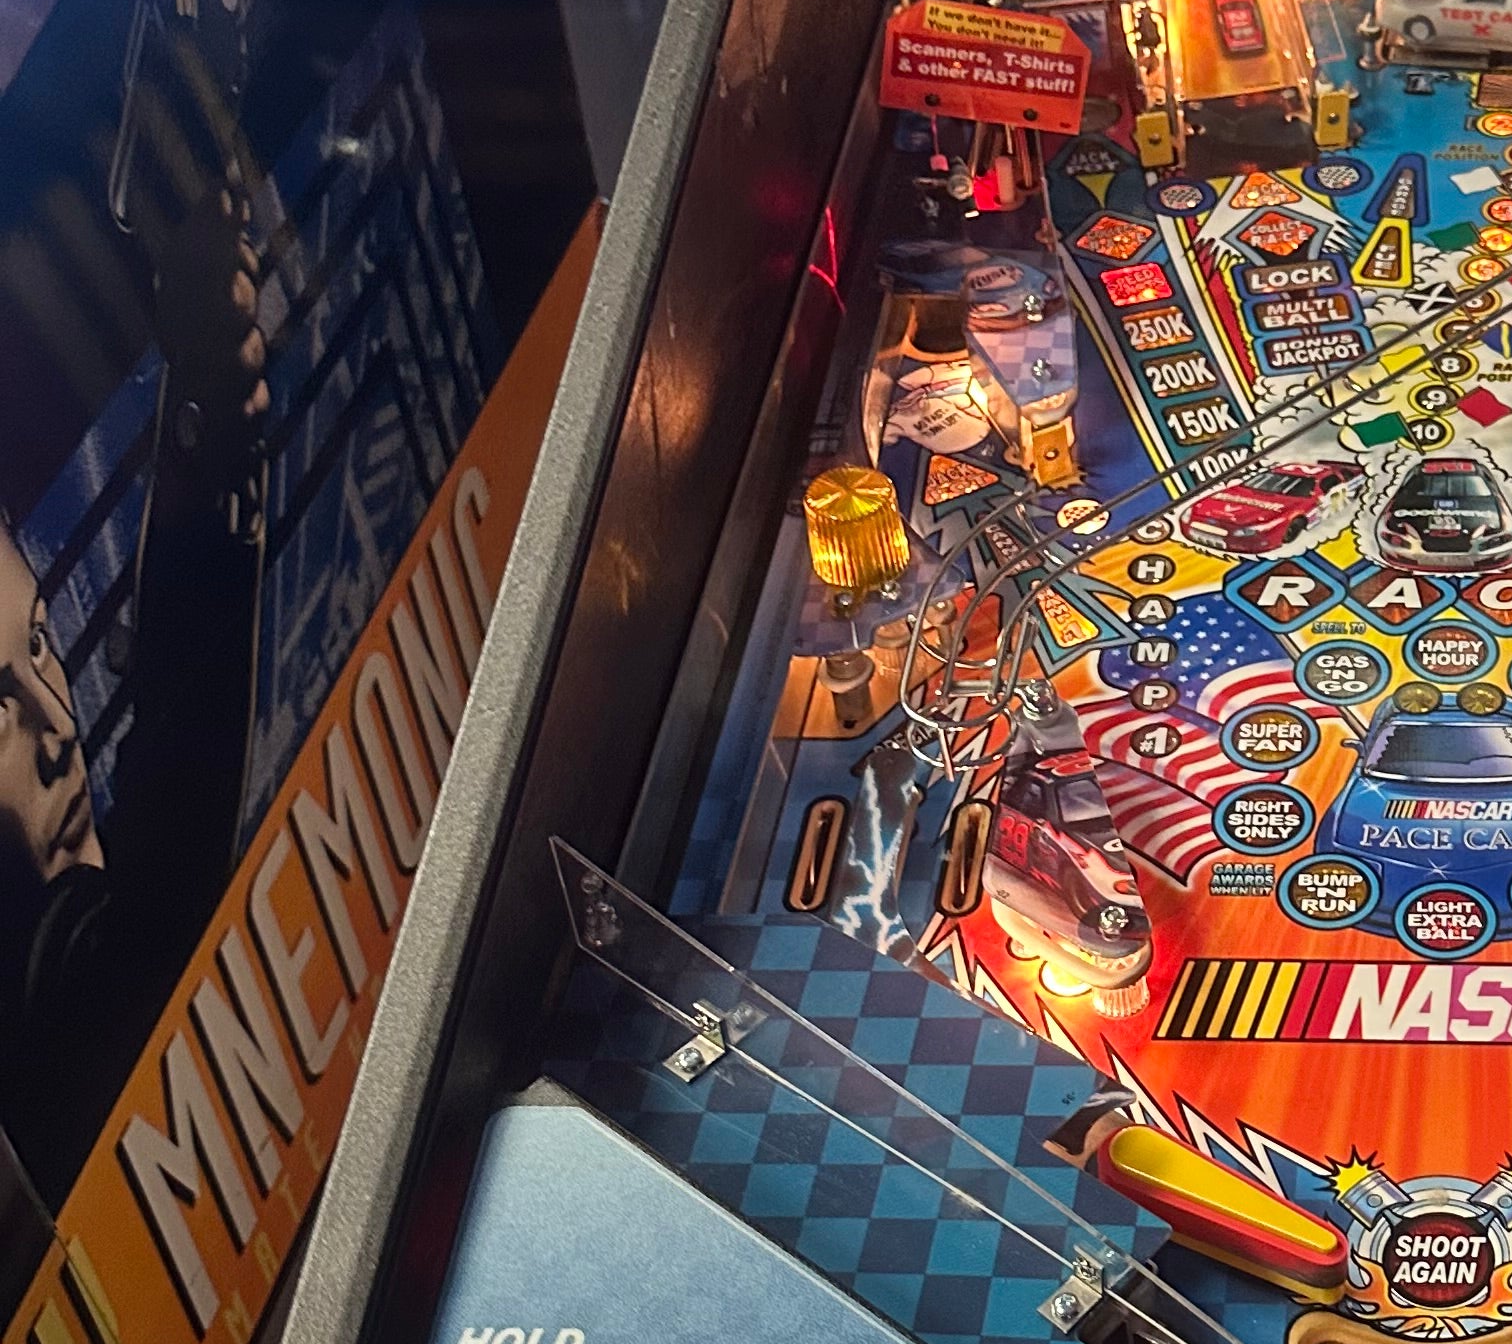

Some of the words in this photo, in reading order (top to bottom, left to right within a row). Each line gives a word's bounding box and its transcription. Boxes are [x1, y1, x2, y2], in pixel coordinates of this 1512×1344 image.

[944, 11, 964, 21] we
[968, 14, 1001, 28] don't
[1005, 20, 1037, 34] have
[1440, 8, 1486, 22] TEST
[928, 18, 953, 33] You
[956, 25, 990, 39] don't
[899, 38, 993, 67] Scanners,
[1003, 52, 1076, 76] T-Shirts
[898, 57, 913, 73] &
[918, 60, 968, 80] other
[973, 67, 1021, 87] FAST
[1025, 76, 1076, 94] stuff!
[1250, 220, 1303, 236] COLLECT
[1250, 265, 1335, 290] LOCK
[1267, 298, 1336, 315] MULTI
[1263, 312, 1351, 329] BALL
[1123, 312, 1195, 348] 250K
[1271, 334, 1354, 353] BONUS
[1270, 343, 1362, 368] JACKPOT
[1440, 358, 1460, 374] 8
[1146, 357, 1217, 393] 200K
[1427, 390, 1447, 407] 9
[1168, 402, 1241, 441] 150K
[1412, 423, 1440, 441] 10
[1137, 521, 1162, 541] C
[1136, 561, 1165, 580] H
[1256, 575, 1316, 606] R
[1366, 577, 1423, 609] A
[1138, 600, 1167, 619] A
[1137, 642, 1170, 663] M
[1417, 639, 1484, 653] HAPPY
[1316, 655, 1371, 669] GAS
[1422, 652, 1479, 667] HOUR
[1142, 685, 1169, 706] P
[1316, 680, 1369, 694] GO
[1238, 722, 1304, 739] SUPER
[1139, 727, 1169, 756] #1
[1237, 738, 1303, 753] FAN
[1234, 799, 1294, 813] RIGHT
[1227, 813, 1301, 827] SIDES
[1233, 826, 1294, 840] ONLY
[1359, 823, 1454, 850] PACE
[1212, 863, 1275, 875] GARAGE
[1210, 874, 1275, 886] AWARDS
[1297, 874, 1363, 887] BUMP
[1300, 899, 1357, 913] RUN
[1416, 901, 1476, 914] LIGHT
[1406, 913, 1484, 928] EXTRA
[1415, 927, 1475, 941] BALL
[1395, 1235, 1487, 1260] SHOOT
[1394, 1259, 1479, 1285] AGAIN
